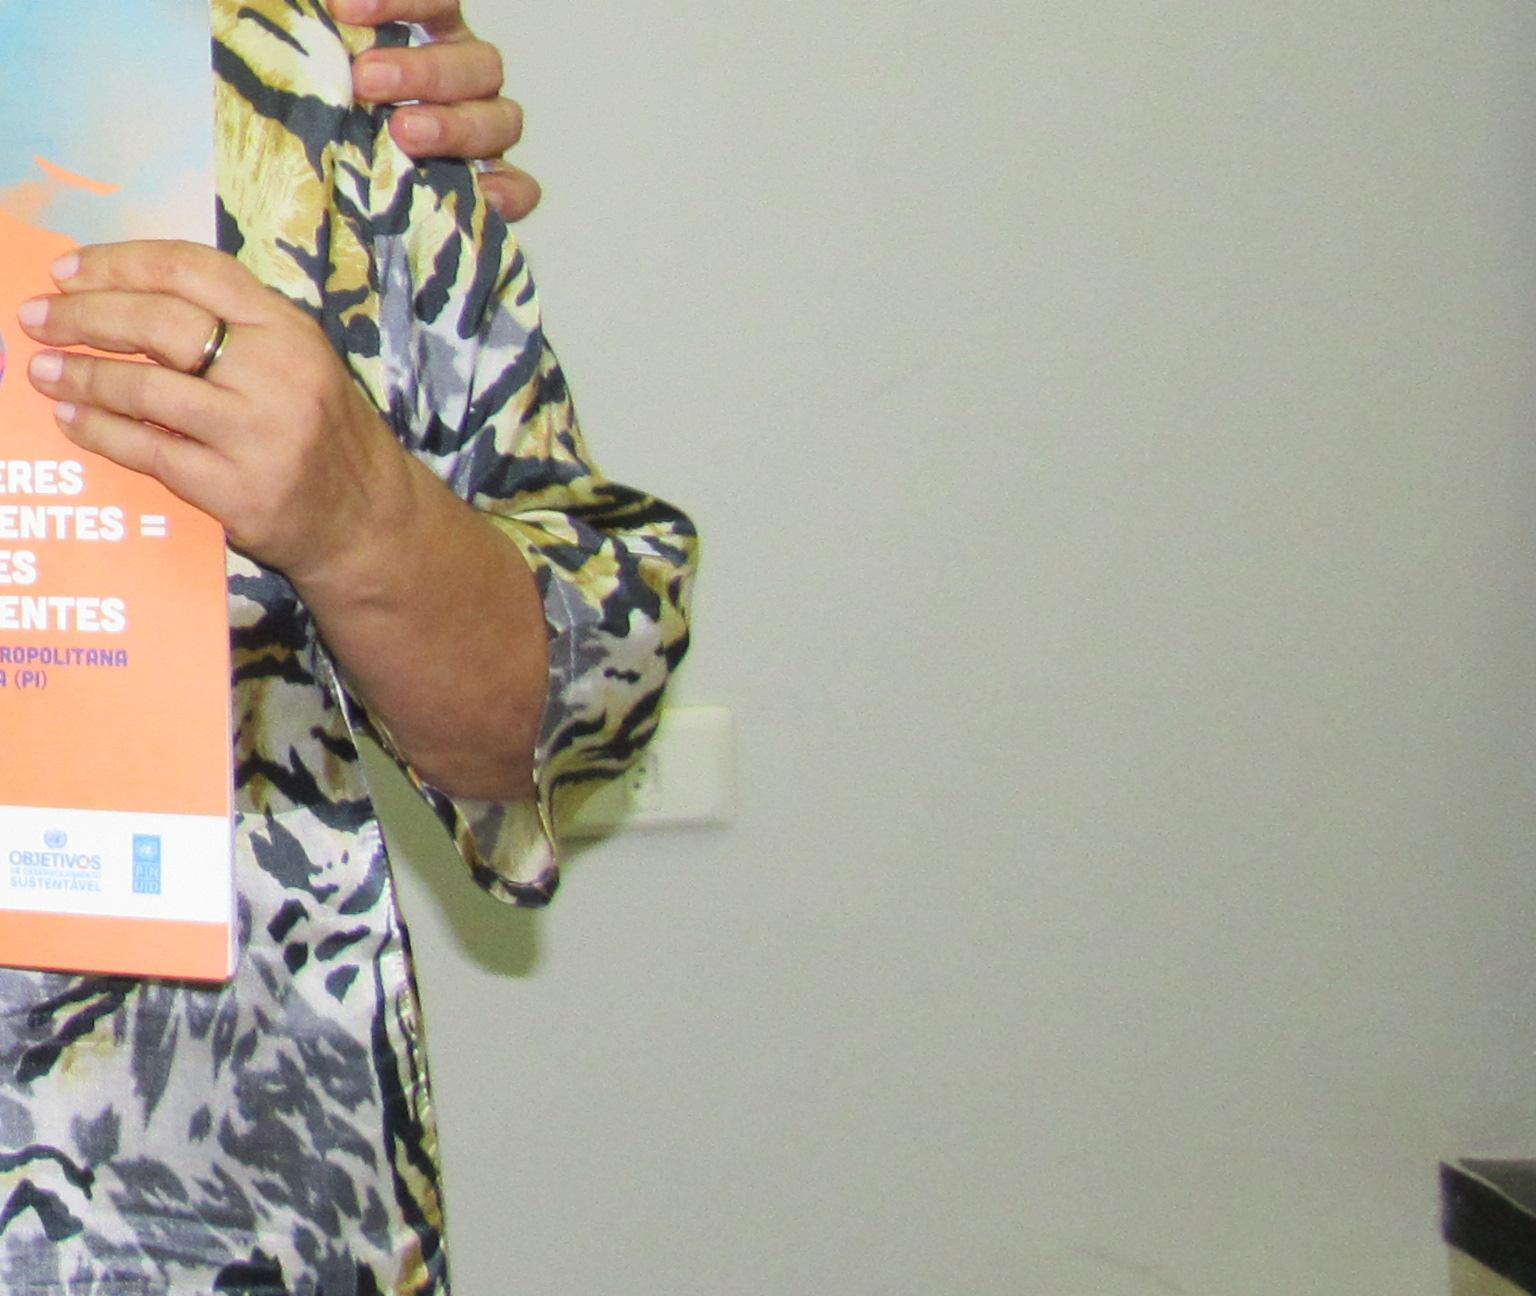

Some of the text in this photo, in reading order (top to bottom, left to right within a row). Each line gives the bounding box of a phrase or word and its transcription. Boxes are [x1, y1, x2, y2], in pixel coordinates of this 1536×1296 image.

[140, 515, 167, 537] =
[14, 670, 48, 691] (PI)
[9, 850, 102, 870] OBJETIVOS
